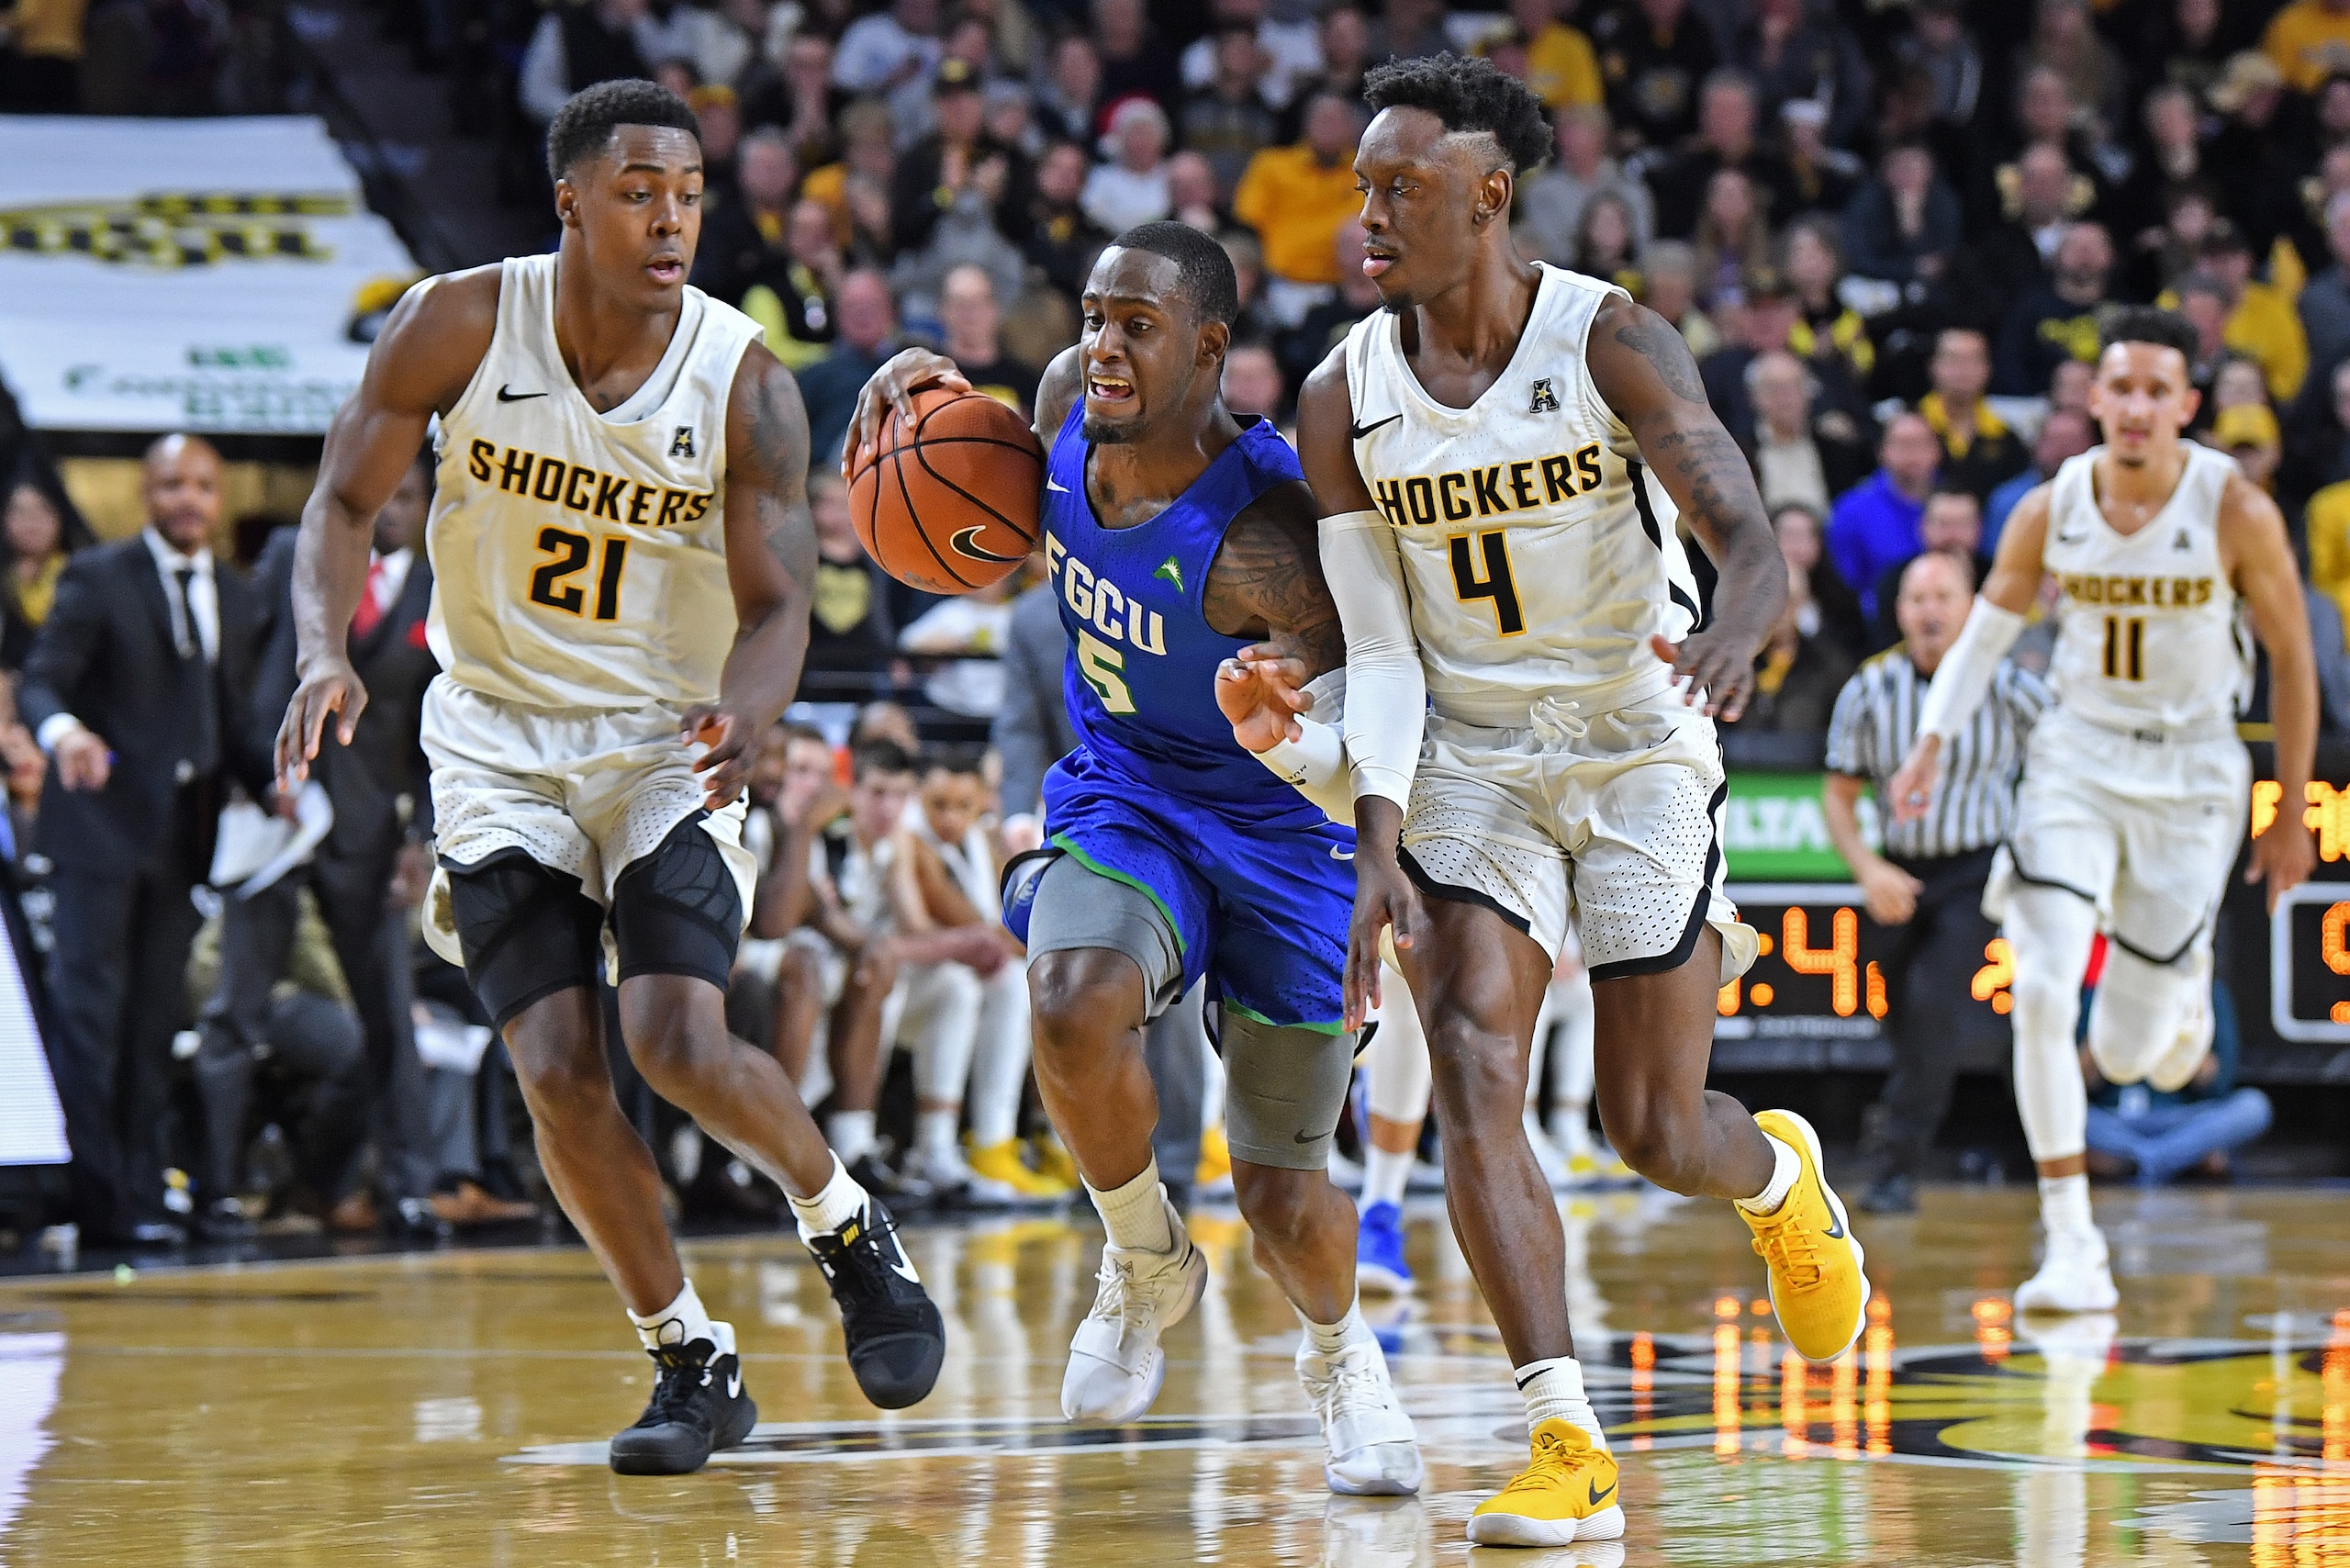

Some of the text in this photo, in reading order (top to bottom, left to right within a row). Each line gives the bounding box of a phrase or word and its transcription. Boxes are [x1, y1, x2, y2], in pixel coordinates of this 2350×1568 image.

[469, 437, 715, 528] SHOCKERS
[1375, 442, 1604, 528] HOCKERS
[527, 523, 631, 622] 21
[1045, 530, 1168, 656] FGCU
[1447, 528, 1528, 638] 4
[2053, 571, 2214, 608] HOCKERS
[1077, 627, 1139, 714] 5
[2101, 613, 2146, 683] 11
